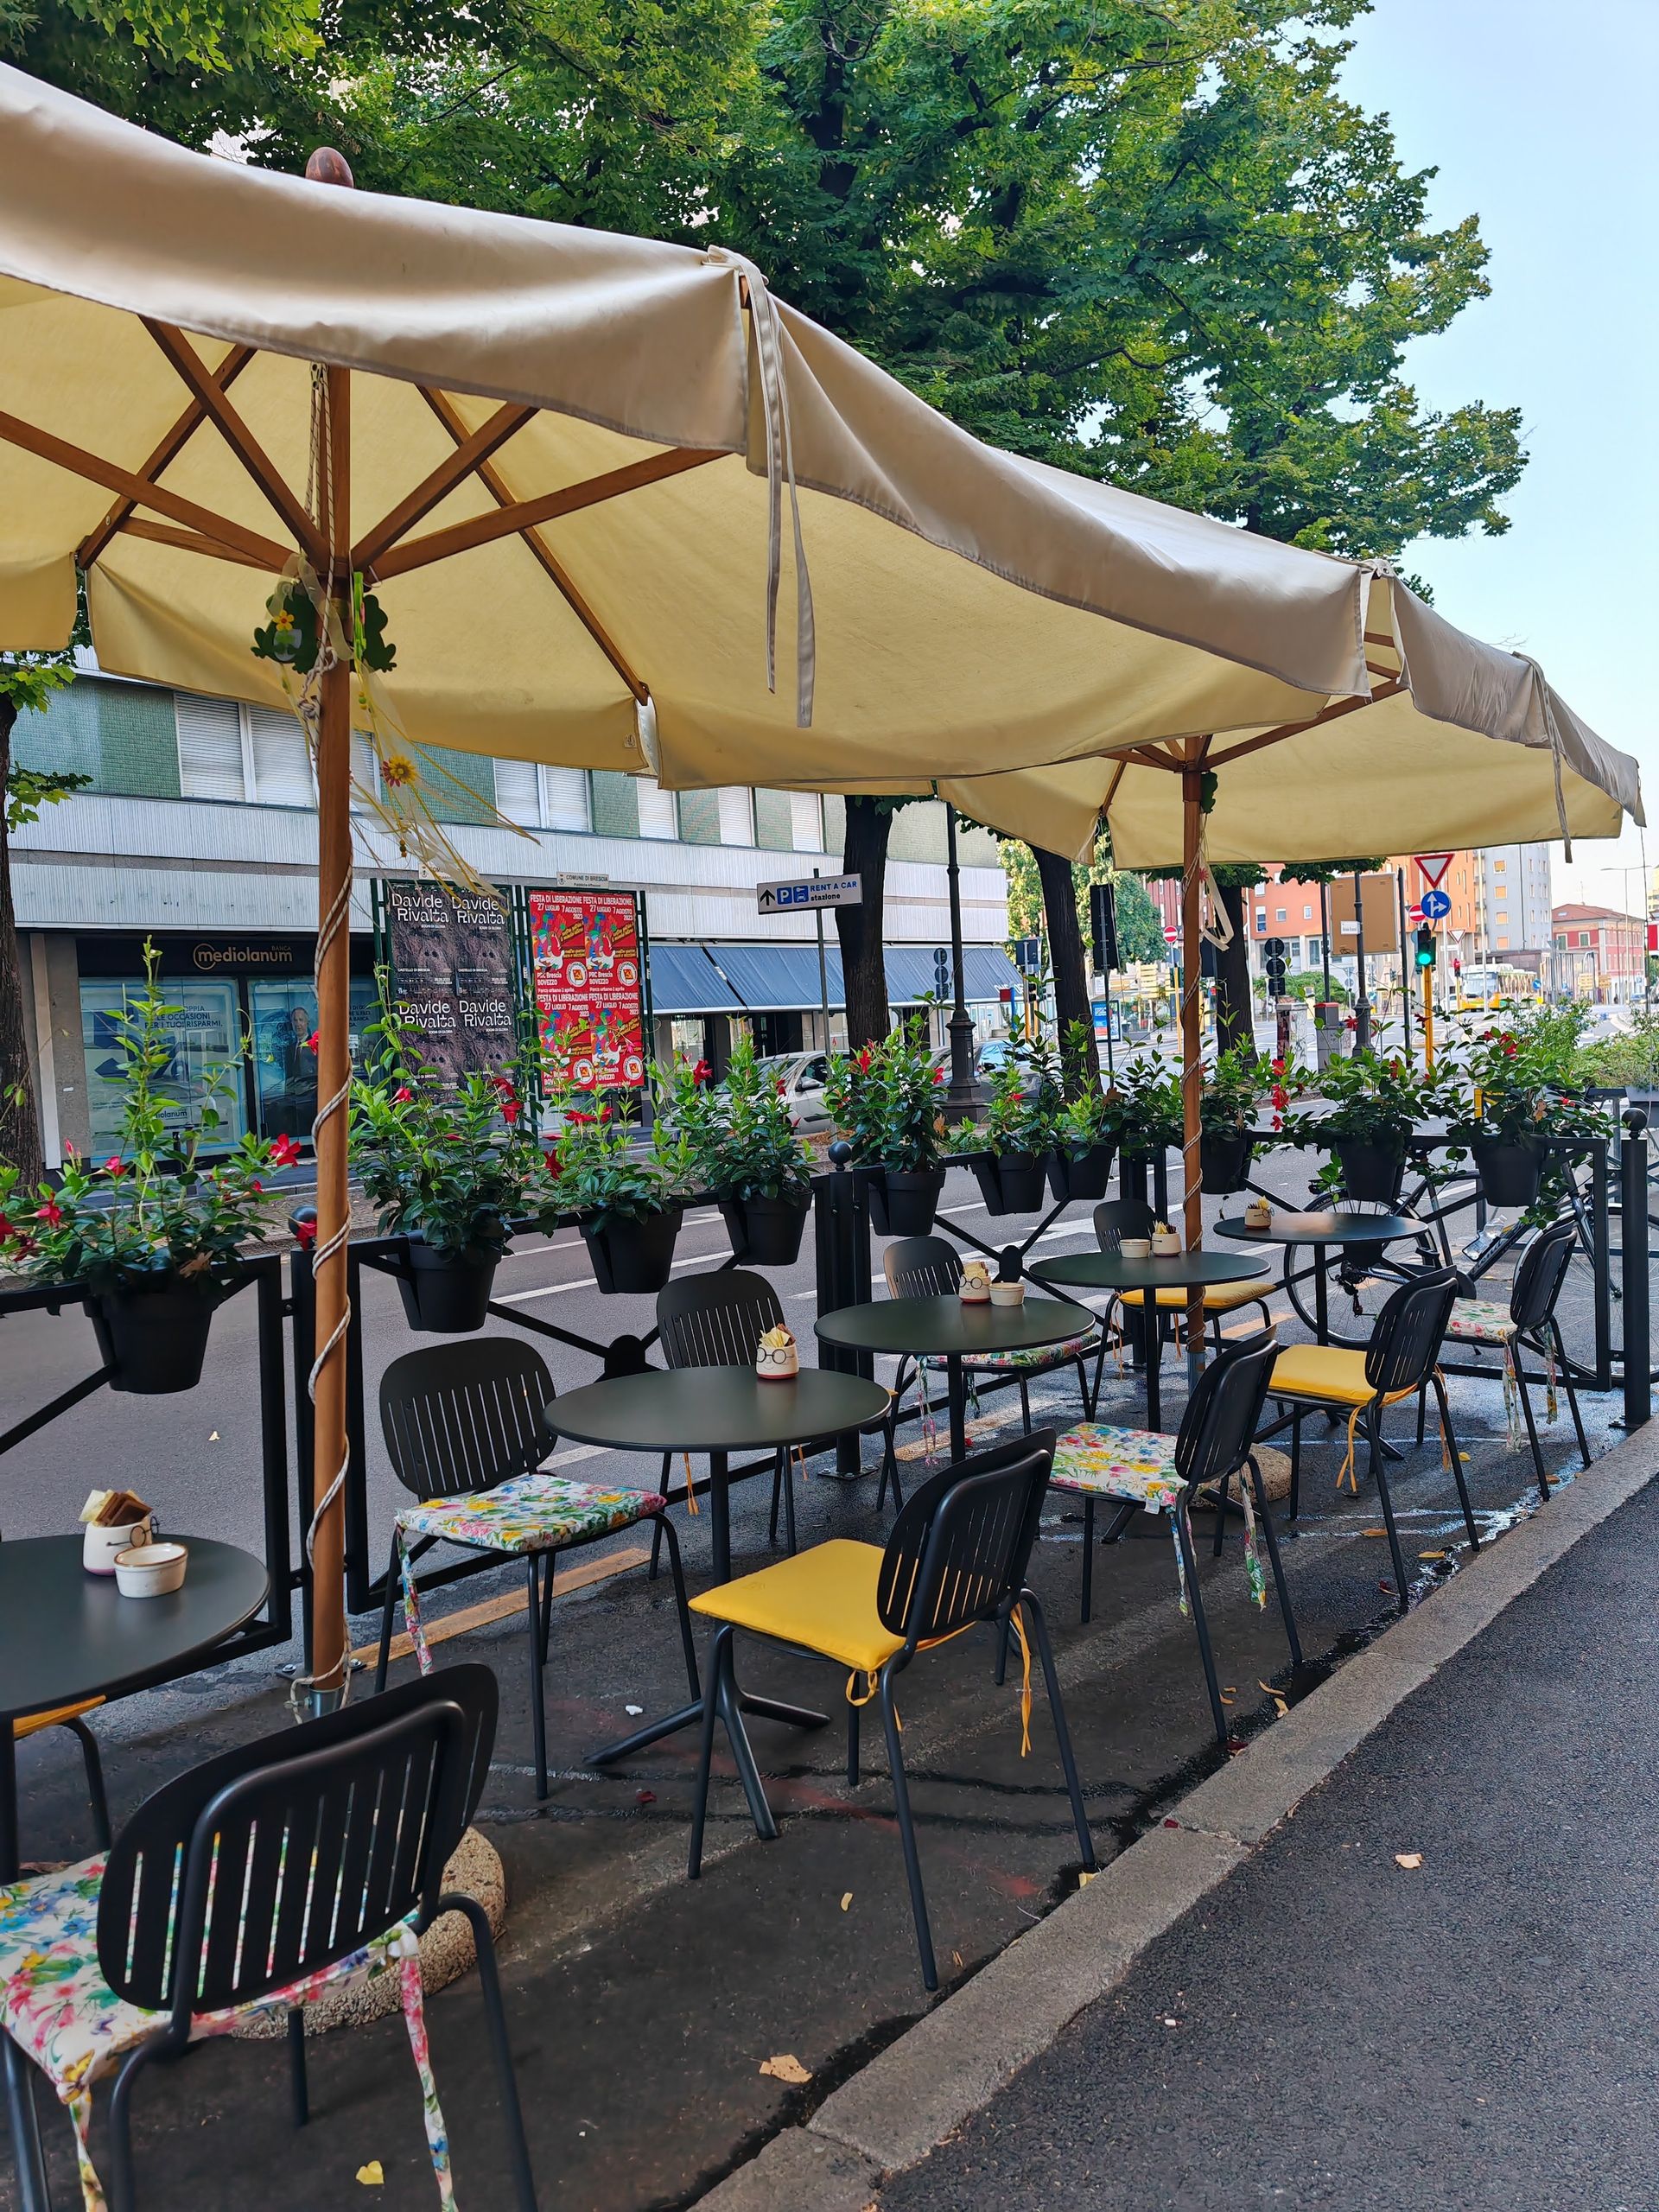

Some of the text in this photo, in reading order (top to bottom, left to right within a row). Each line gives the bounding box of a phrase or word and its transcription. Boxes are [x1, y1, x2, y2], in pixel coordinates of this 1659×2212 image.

[810, 884, 831, 892] RENT
[391, 893, 443, 908] Davide
[452, 896, 499, 910] Davide
[530, 895, 545, 903] FESTA
[552, 896, 582, 904] LIBERAZIONE
[397, 908, 449, 922] Rivalta
[457, 911, 505, 924] Rivalta
[197, 947, 292, 962] mediolanum
[399, 1000, 451, 1015] Davide
[459, 999, 506, 1013] Davide
[168, 1012, 210, 1020] OCCASIONI
[405, 1015, 456, 1028] Rivalta
[464, 1013, 512, 1027] Rivalta
